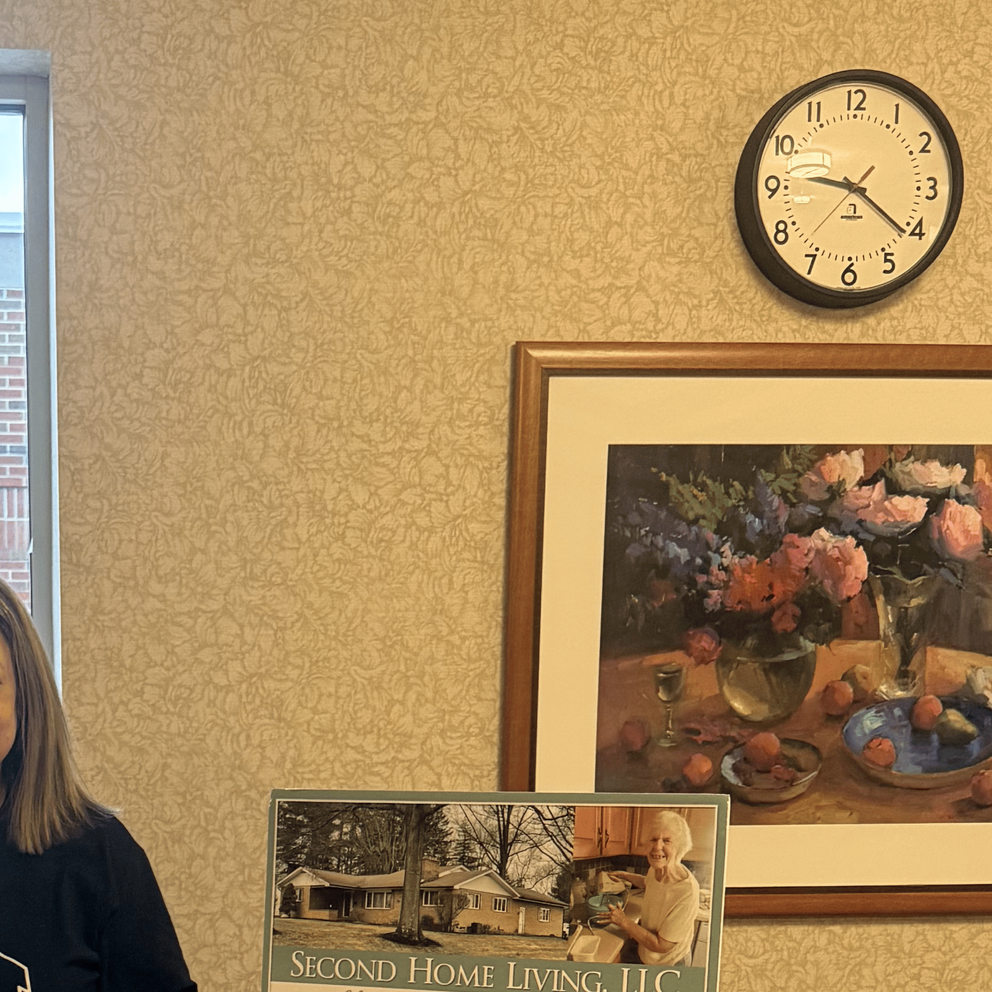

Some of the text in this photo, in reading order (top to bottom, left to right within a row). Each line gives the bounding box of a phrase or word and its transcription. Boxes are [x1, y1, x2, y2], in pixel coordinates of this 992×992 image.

[847, 89, 866, 111] 12
[807, 101, 821, 122] 11
[894, 103, 899, 124] 1
[775, 135, 794, 155] 10
[918, 132, 931, 153] 2
[765, 175, 780, 199] 9
[925, 177, 937, 200] 3
[774, 220, 789, 245] 8
[909, 216, 925, 240] 4
[805, 254, 817, 275] 7
[841, 263, 857, 286] 6
[883, 253, 895, 274] 5
[290, 950, 397, 982] SECOND
[408, 956, 494, 990] HOME
